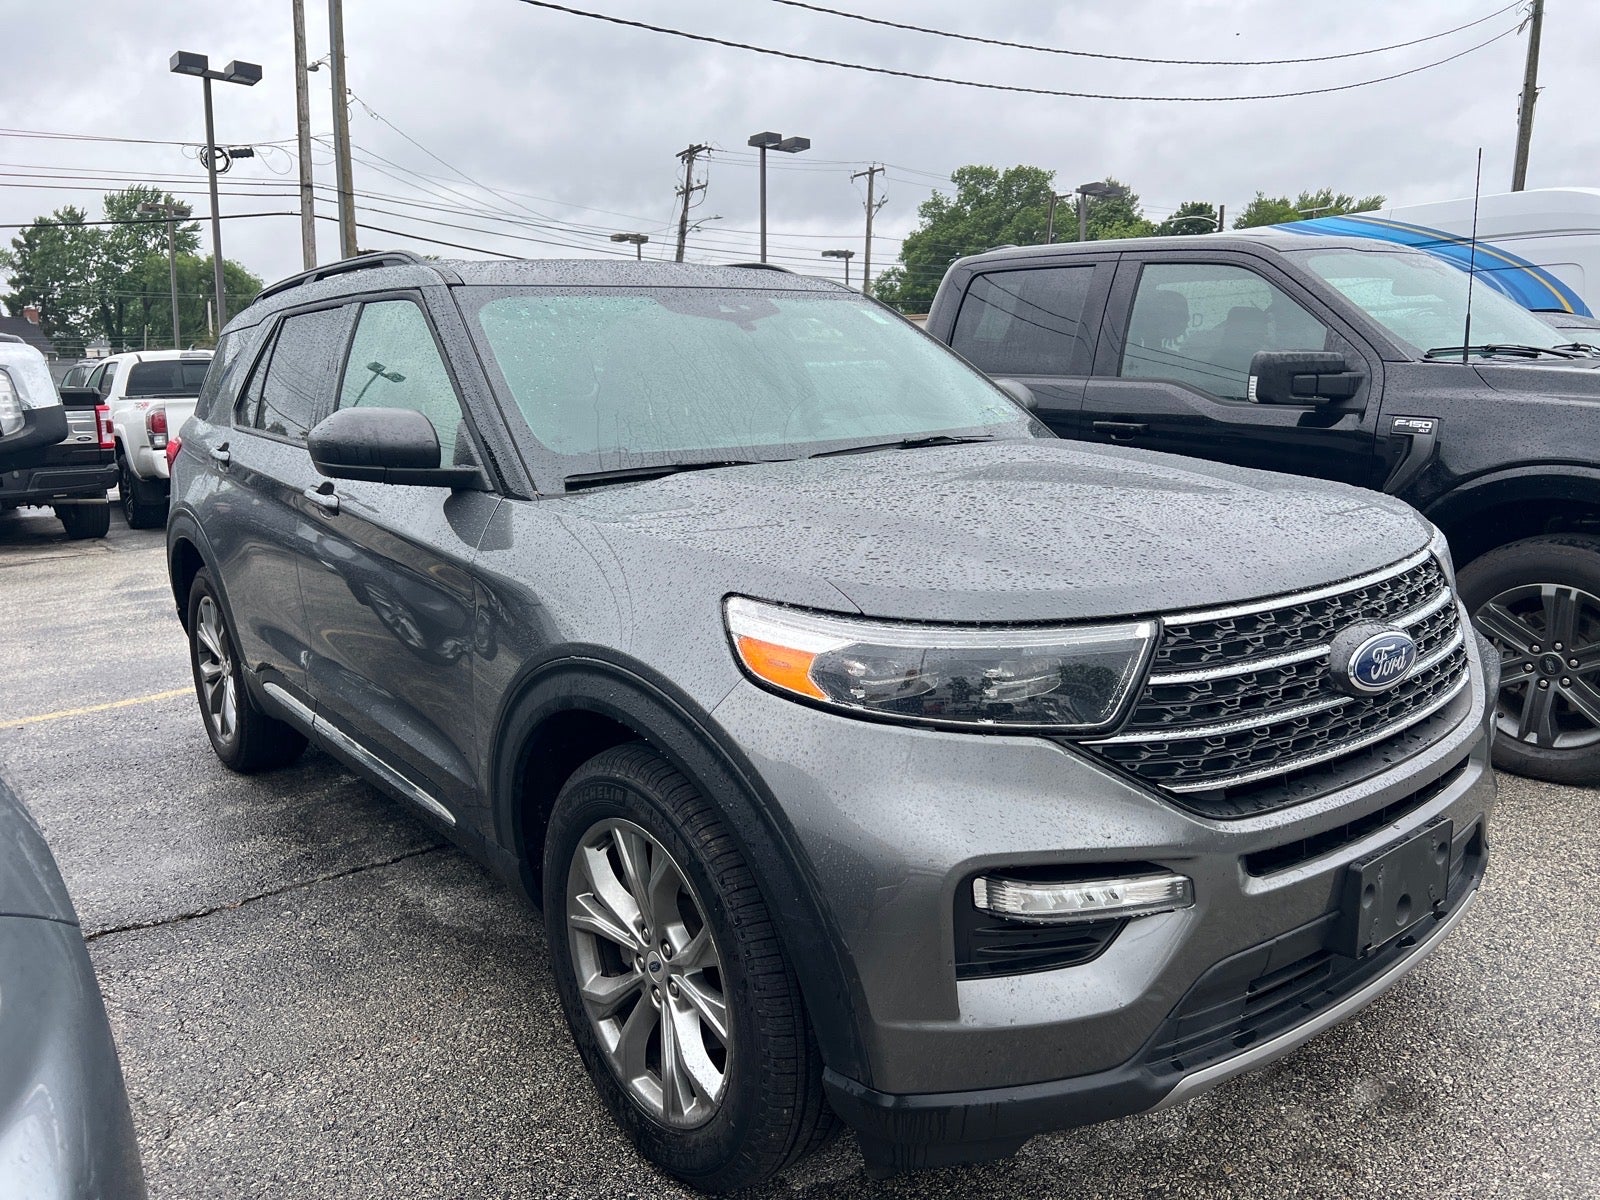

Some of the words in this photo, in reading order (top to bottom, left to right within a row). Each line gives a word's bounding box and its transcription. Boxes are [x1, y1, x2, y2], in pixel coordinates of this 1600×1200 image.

[1394, 419, 1433, 429] F-150
[1371, 644, 1407, 680] Ford
[572, 785, 624, 809] MICHELIN
